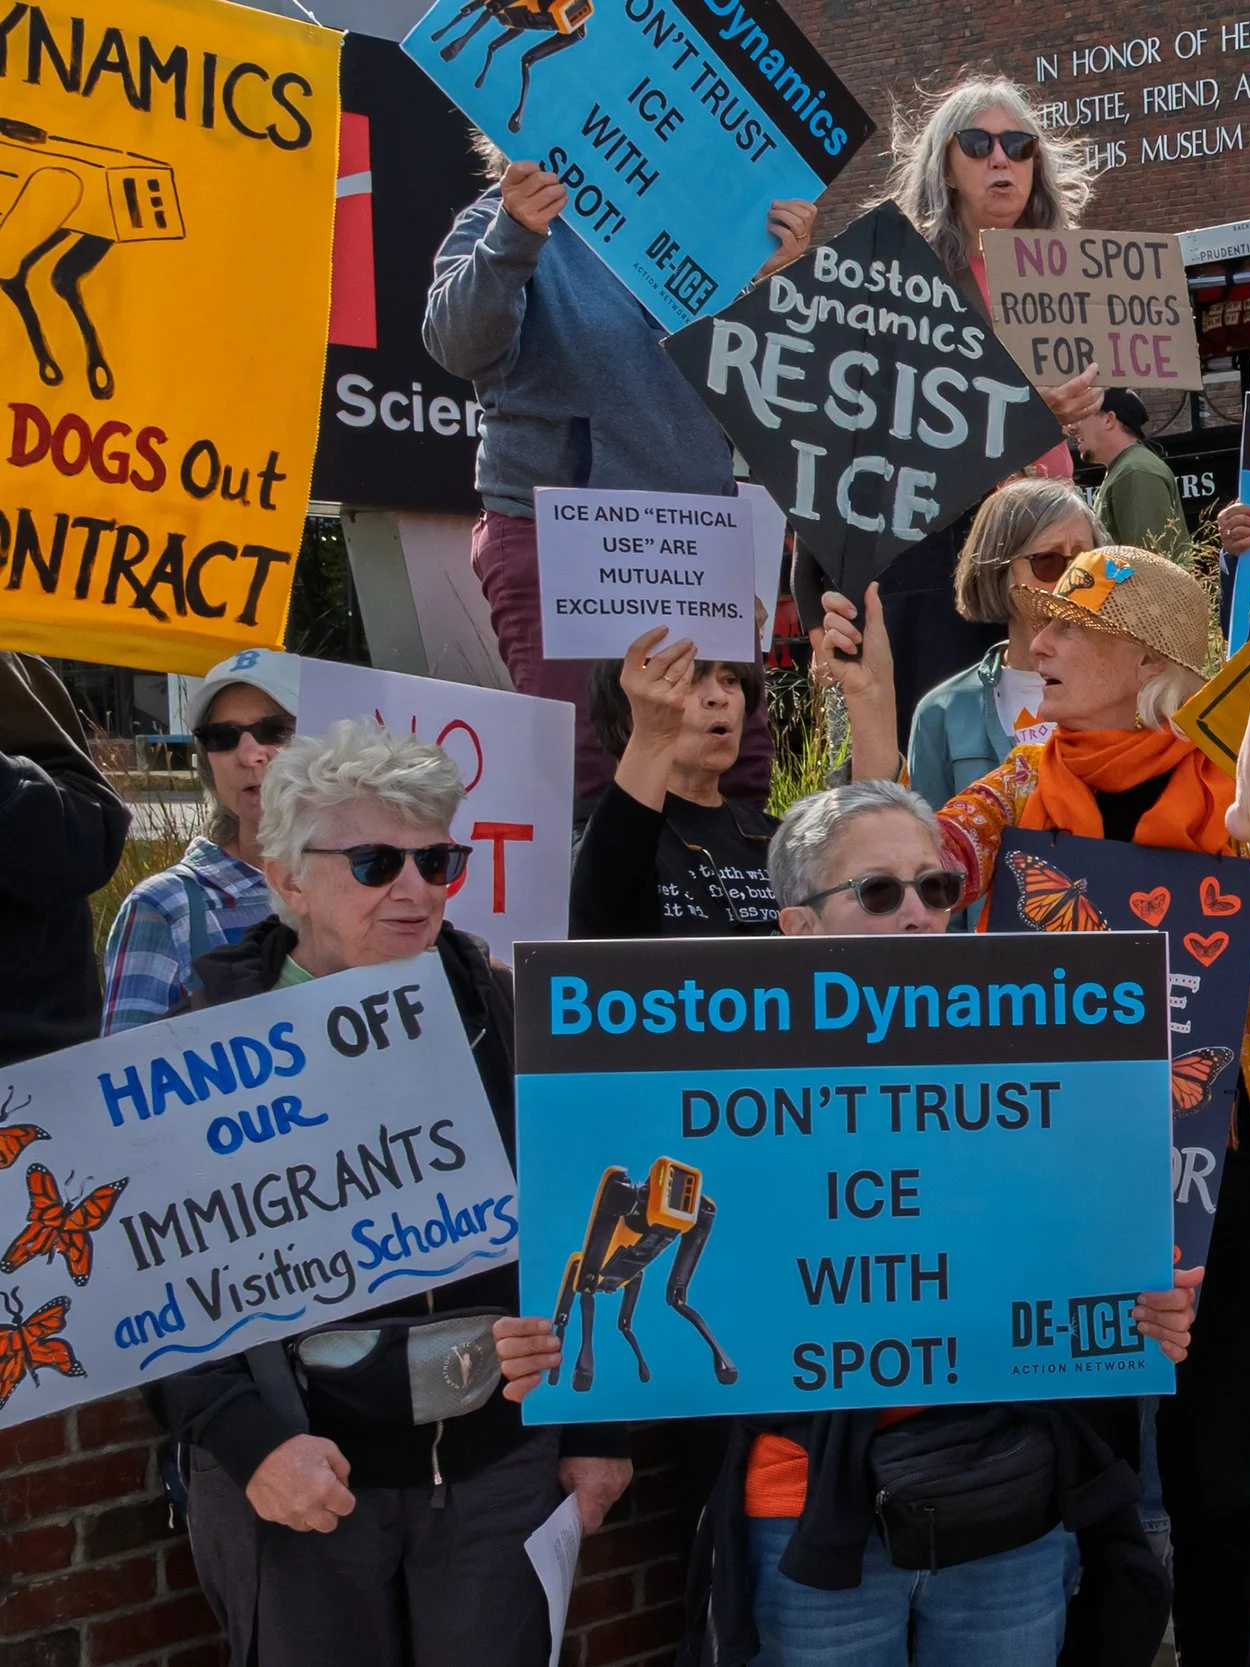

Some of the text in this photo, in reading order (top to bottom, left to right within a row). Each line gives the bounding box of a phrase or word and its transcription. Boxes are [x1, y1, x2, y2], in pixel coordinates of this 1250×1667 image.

[1036, 54, 1058, 82] IN
[1072, 36, 1162, 77] HONOR
[1174, 28, 1208, 59] OF
[627, 76, 685, 143] ICE
[690, 60, 777, 164] TRUST
[1143, 78, 1220, 112] FRIEND,
[581, 102, 660, 197] WITH
[1141, 123, 1243, 164] MUSEUM
[539, 146, 627, 243] SPOT!
[1233, 222, 1249, 232] BACK
[645, 229, 719, 316] DE-ICE
[814, 246, 967, 313] Boston
[1014, 236, 1168, 281] NO SPOT
[633, 262, 690, 324] ACTION NETWORK
[769, 275, 985, 360] Dynamics
[1000, 292, 1091, 325] ROBOT
[1107, 294, 1180, 326] DOGS
[1031, 332, 1178, 378] FOR ICE
[706, 318, 1030, 459] RESIST
[6, 402, 287, 510] DOGS Out
[789, 439, 941, 541] ICE
[1174, 471, 1216, 498] RS
[554, 505, 737, 528] ICE AND “ETHICAL
[602, 537, 698, 555] USE” ARE
[599, 568, 704, 586] MUTUALLY
[556, 599, 743, 619] EXCLUSIVE TERMS.
[663, 902, 684, 918] it
[746, 885, 777, 900] but
[550, 968, 1146, 1044] Boston Dynamics
[97, 984, 425, 1128] HANDS OFF
[205, 1094, 329, 1155] OUR
[880, 1081, 1061, 1133] TRUST
[119, 1119, 466, 1272] IMMIGRANTS
[826, 1168, 922, 1220] ICE
[114, 1192, 519, 1350] and Visiting Scholars
[796, 1252, 949, 1306] WITH
[1012, 1292, 1145, 1358] DE-ICE
[792, 1336, 959, 1391] SPOT!
[1012, 1359, 1146, 1375] ACTION NETWORK
